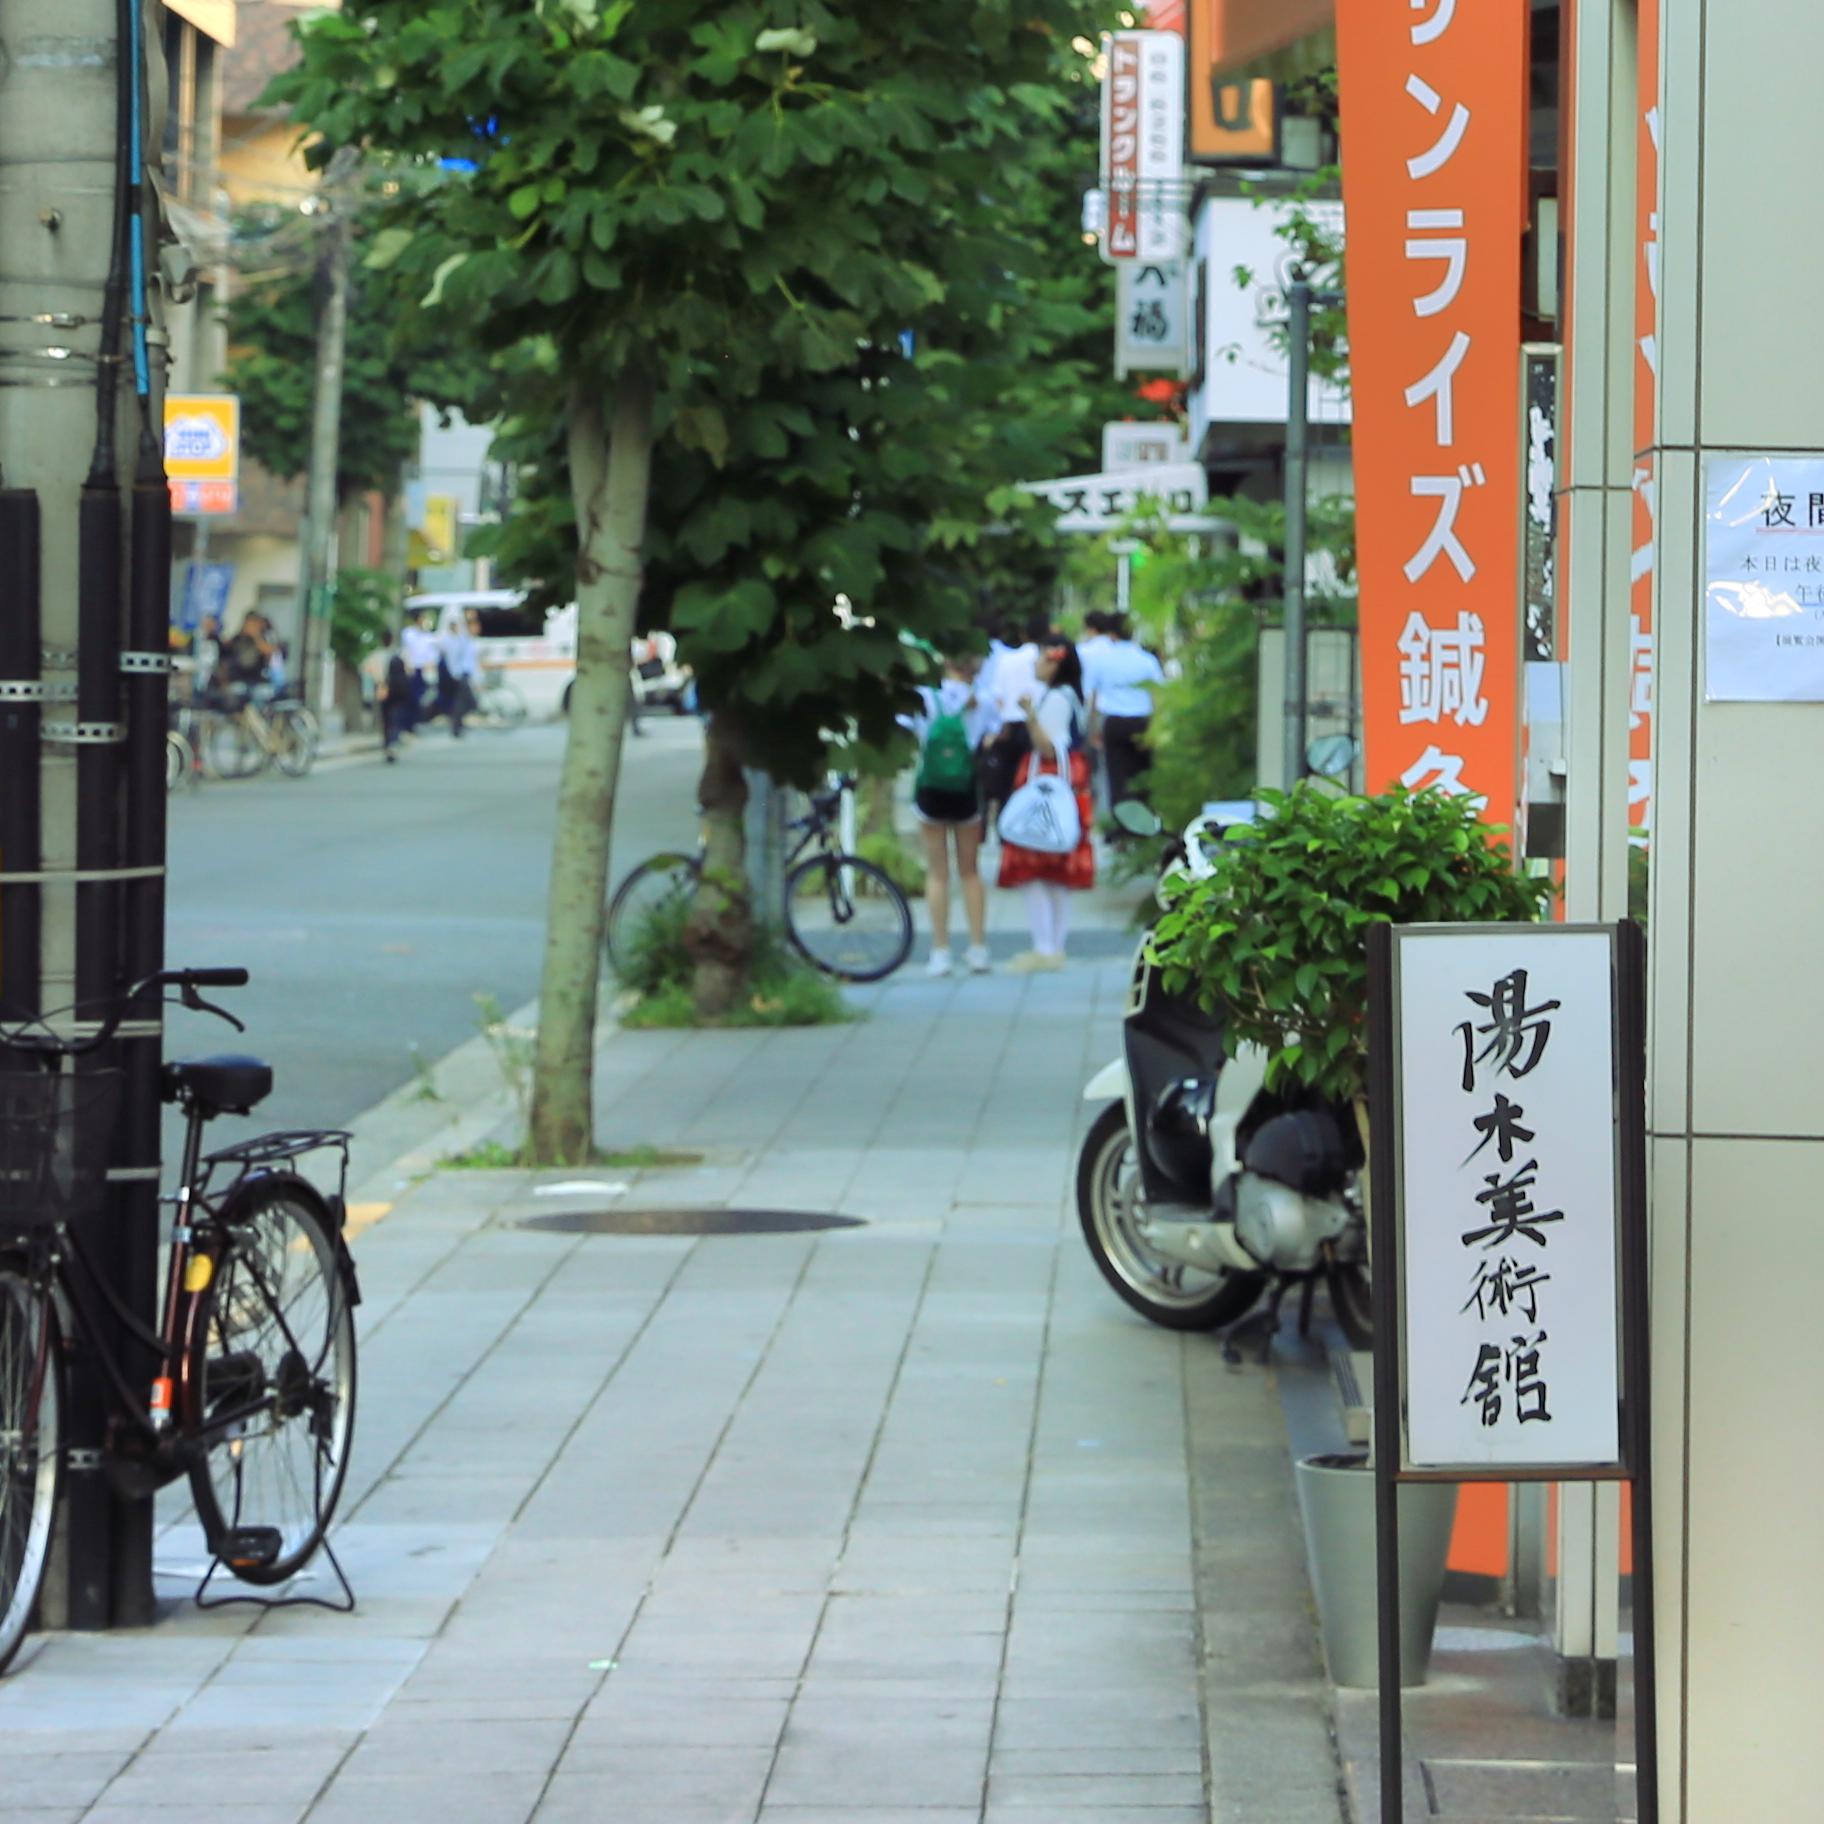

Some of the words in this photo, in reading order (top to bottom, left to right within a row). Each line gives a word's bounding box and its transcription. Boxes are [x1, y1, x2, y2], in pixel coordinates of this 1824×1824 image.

[1111, 44, 1137, 251] トランクルーム
[1062, 487, 1192, 517] スエロ
[1452, 969, 1564, 1428] 湯木美術館
